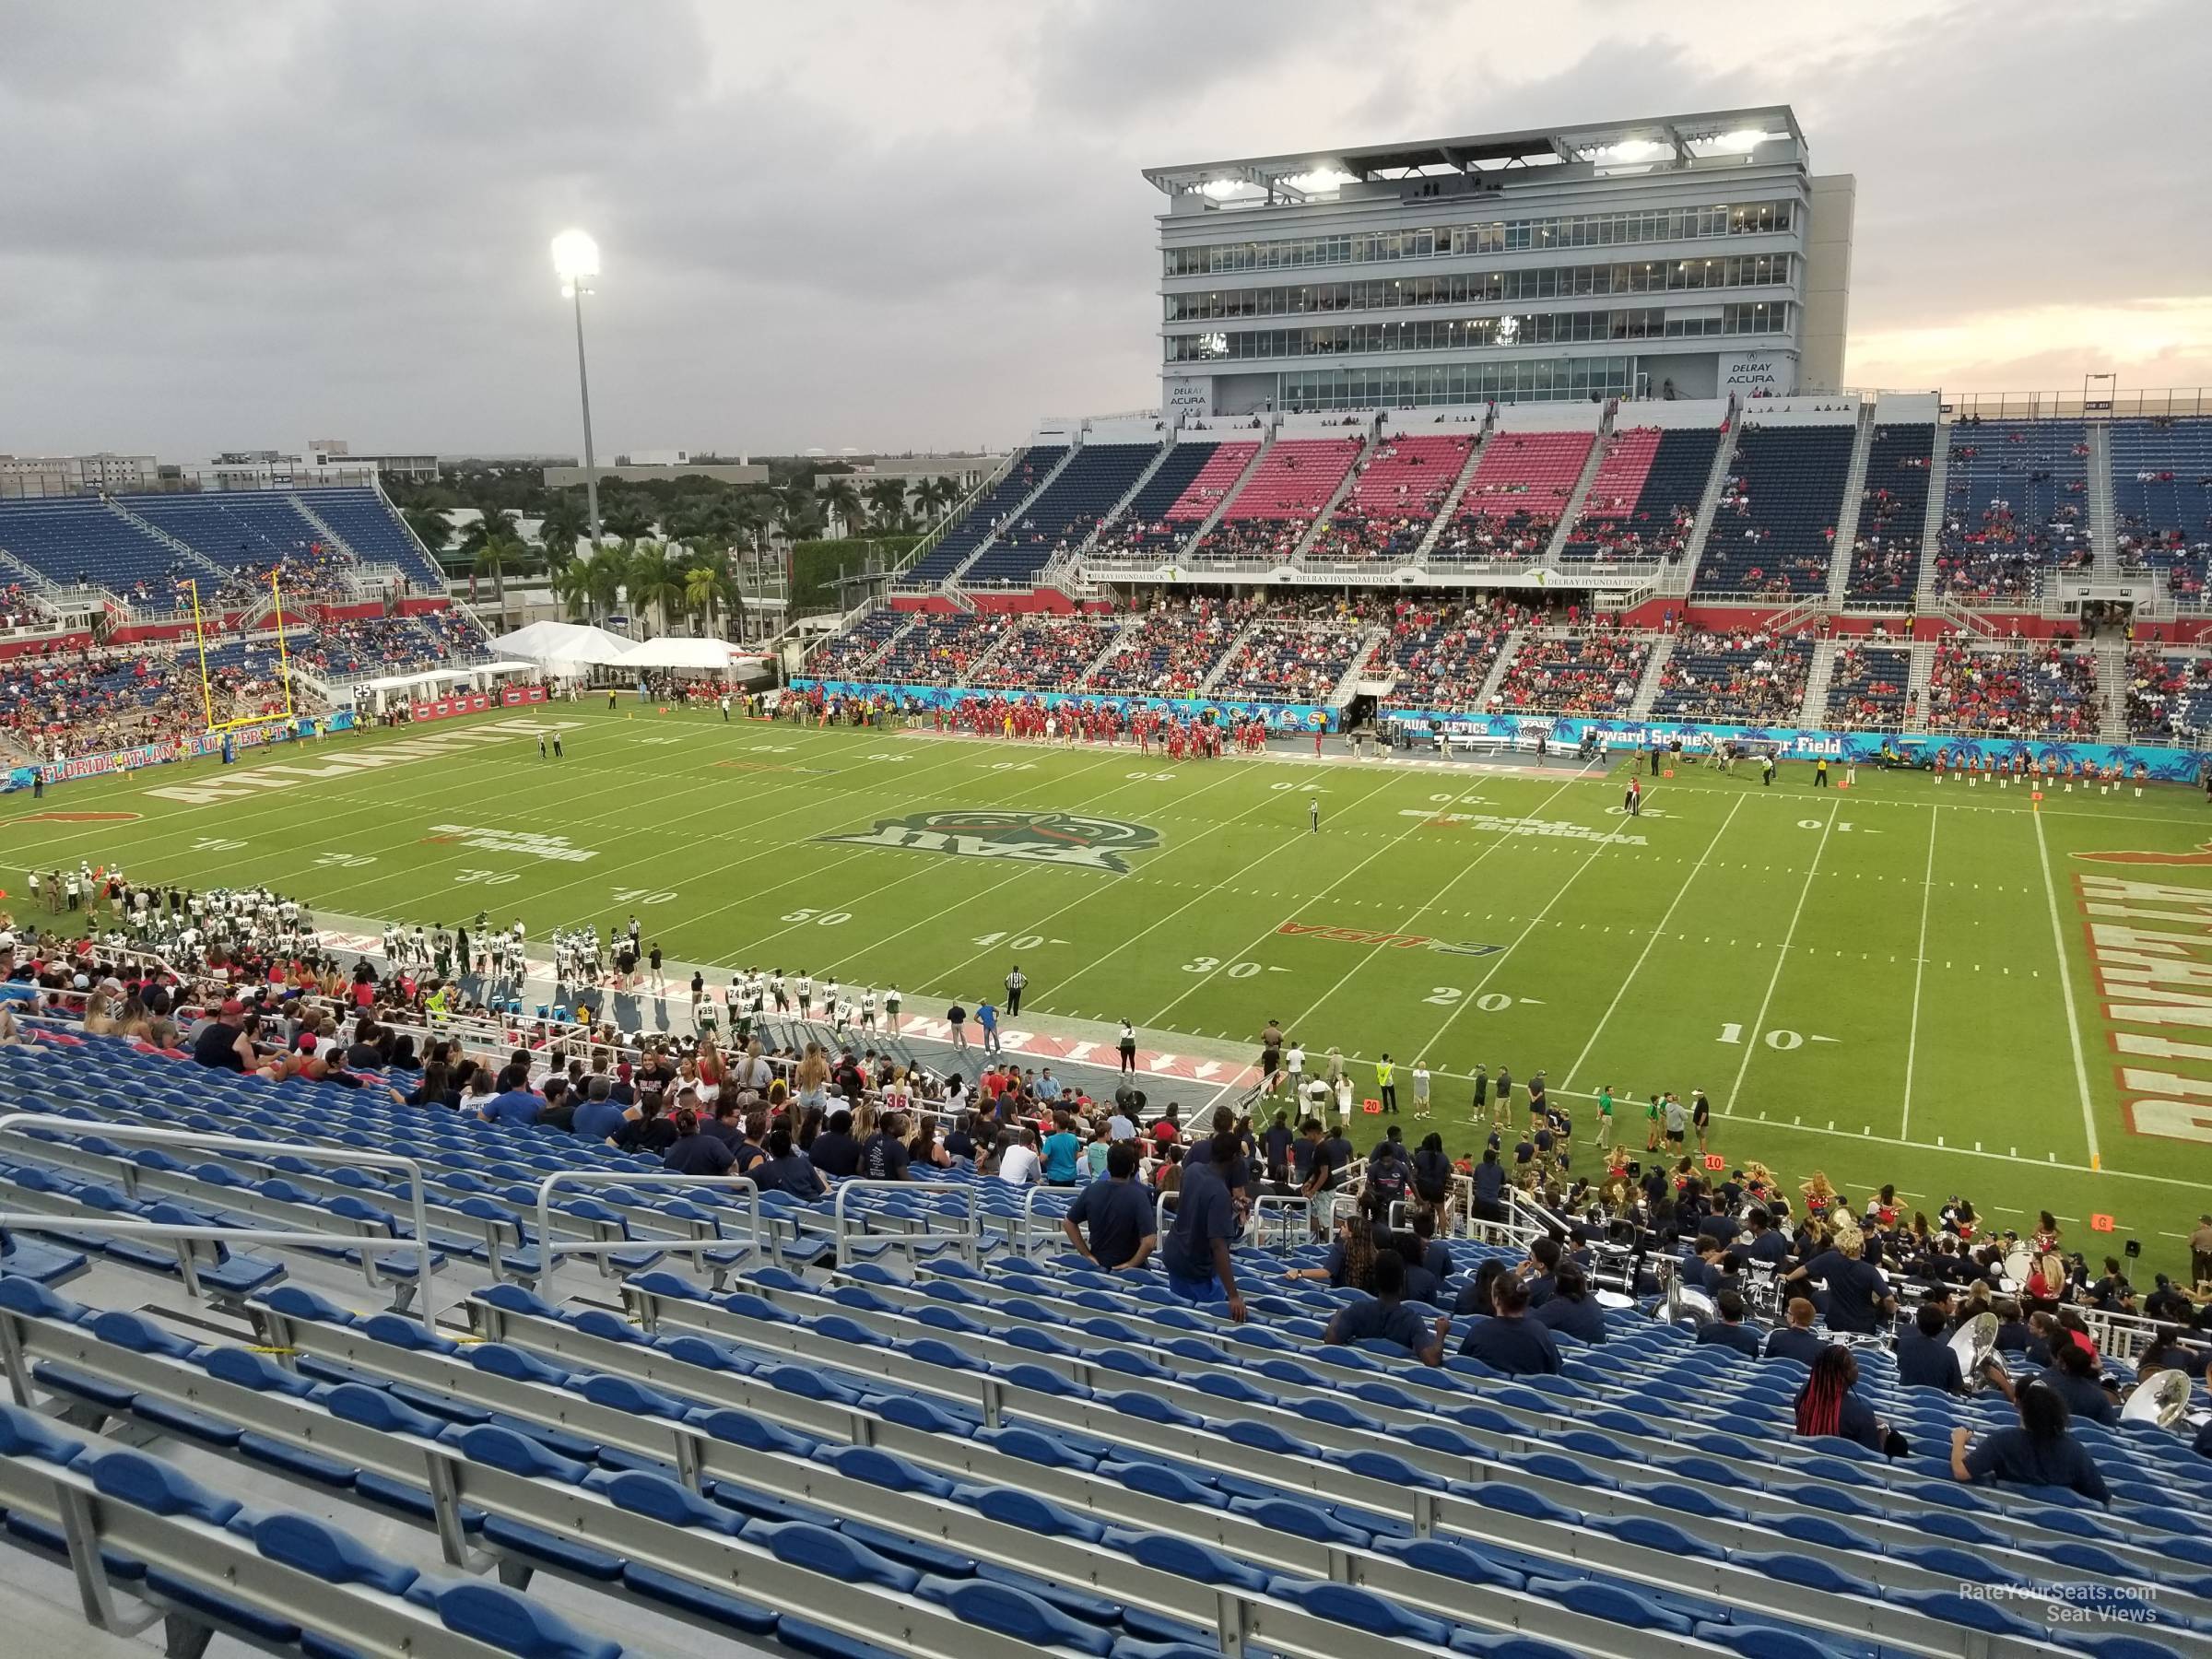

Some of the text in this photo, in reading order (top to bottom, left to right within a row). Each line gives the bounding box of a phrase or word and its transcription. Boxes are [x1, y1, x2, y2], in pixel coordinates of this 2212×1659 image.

[1733, 364, 1771, 372] DELRAY
[1727, 375, 1775, 383] ACURA
[355, 686, 371, 697] 25
[1796, 736, 1841, 753] Field
[142, 719, 587, 804] ATLANTIC
[41, 754, 118, 782] FLORIDA
[1797, 819, 1853, 832] 10
[454, 870, 522, 885] 30
[612, 888, 679, 904] 40
[780, 908, 853, 925] 50
[971, 931, 1044, 950] 40
[1182, 956, 1262, 978] 30
[751, 985, 760, 994] 85
[800, 982, 808, 991] 16
[729, 990, 739, 998] 74
[1421, 987, 1512, 1012] 20
[702, 1006, 713, 1015] 39
[744, 1004, 753, 1012] 62
[838, 1004, 847, 1013] 46
[1715, 1022, 1804, 1050] 10
[887, 1093, 907, 1108] 36
[1366, 1100, 1377, 1111] 20
[1707, 1157, 1722, 1169] 10
[2099, 1217, 2107, 1229] G
